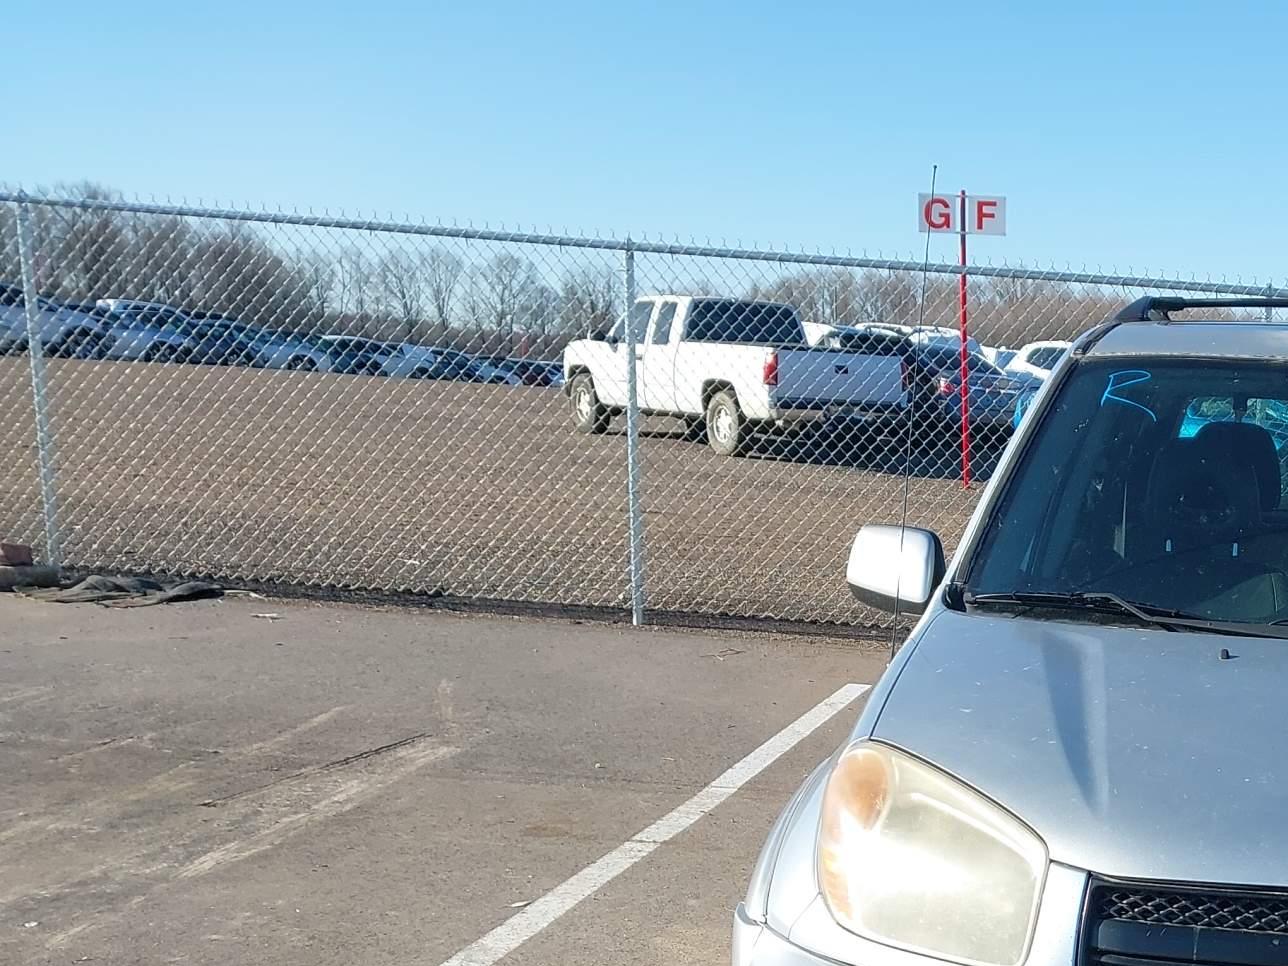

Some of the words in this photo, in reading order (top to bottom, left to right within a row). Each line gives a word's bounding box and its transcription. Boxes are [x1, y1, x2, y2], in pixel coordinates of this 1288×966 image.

[924, 198, 951, 229] G
[976, 200, 998, 230] F
[1101, 369, 1157, 423] R
